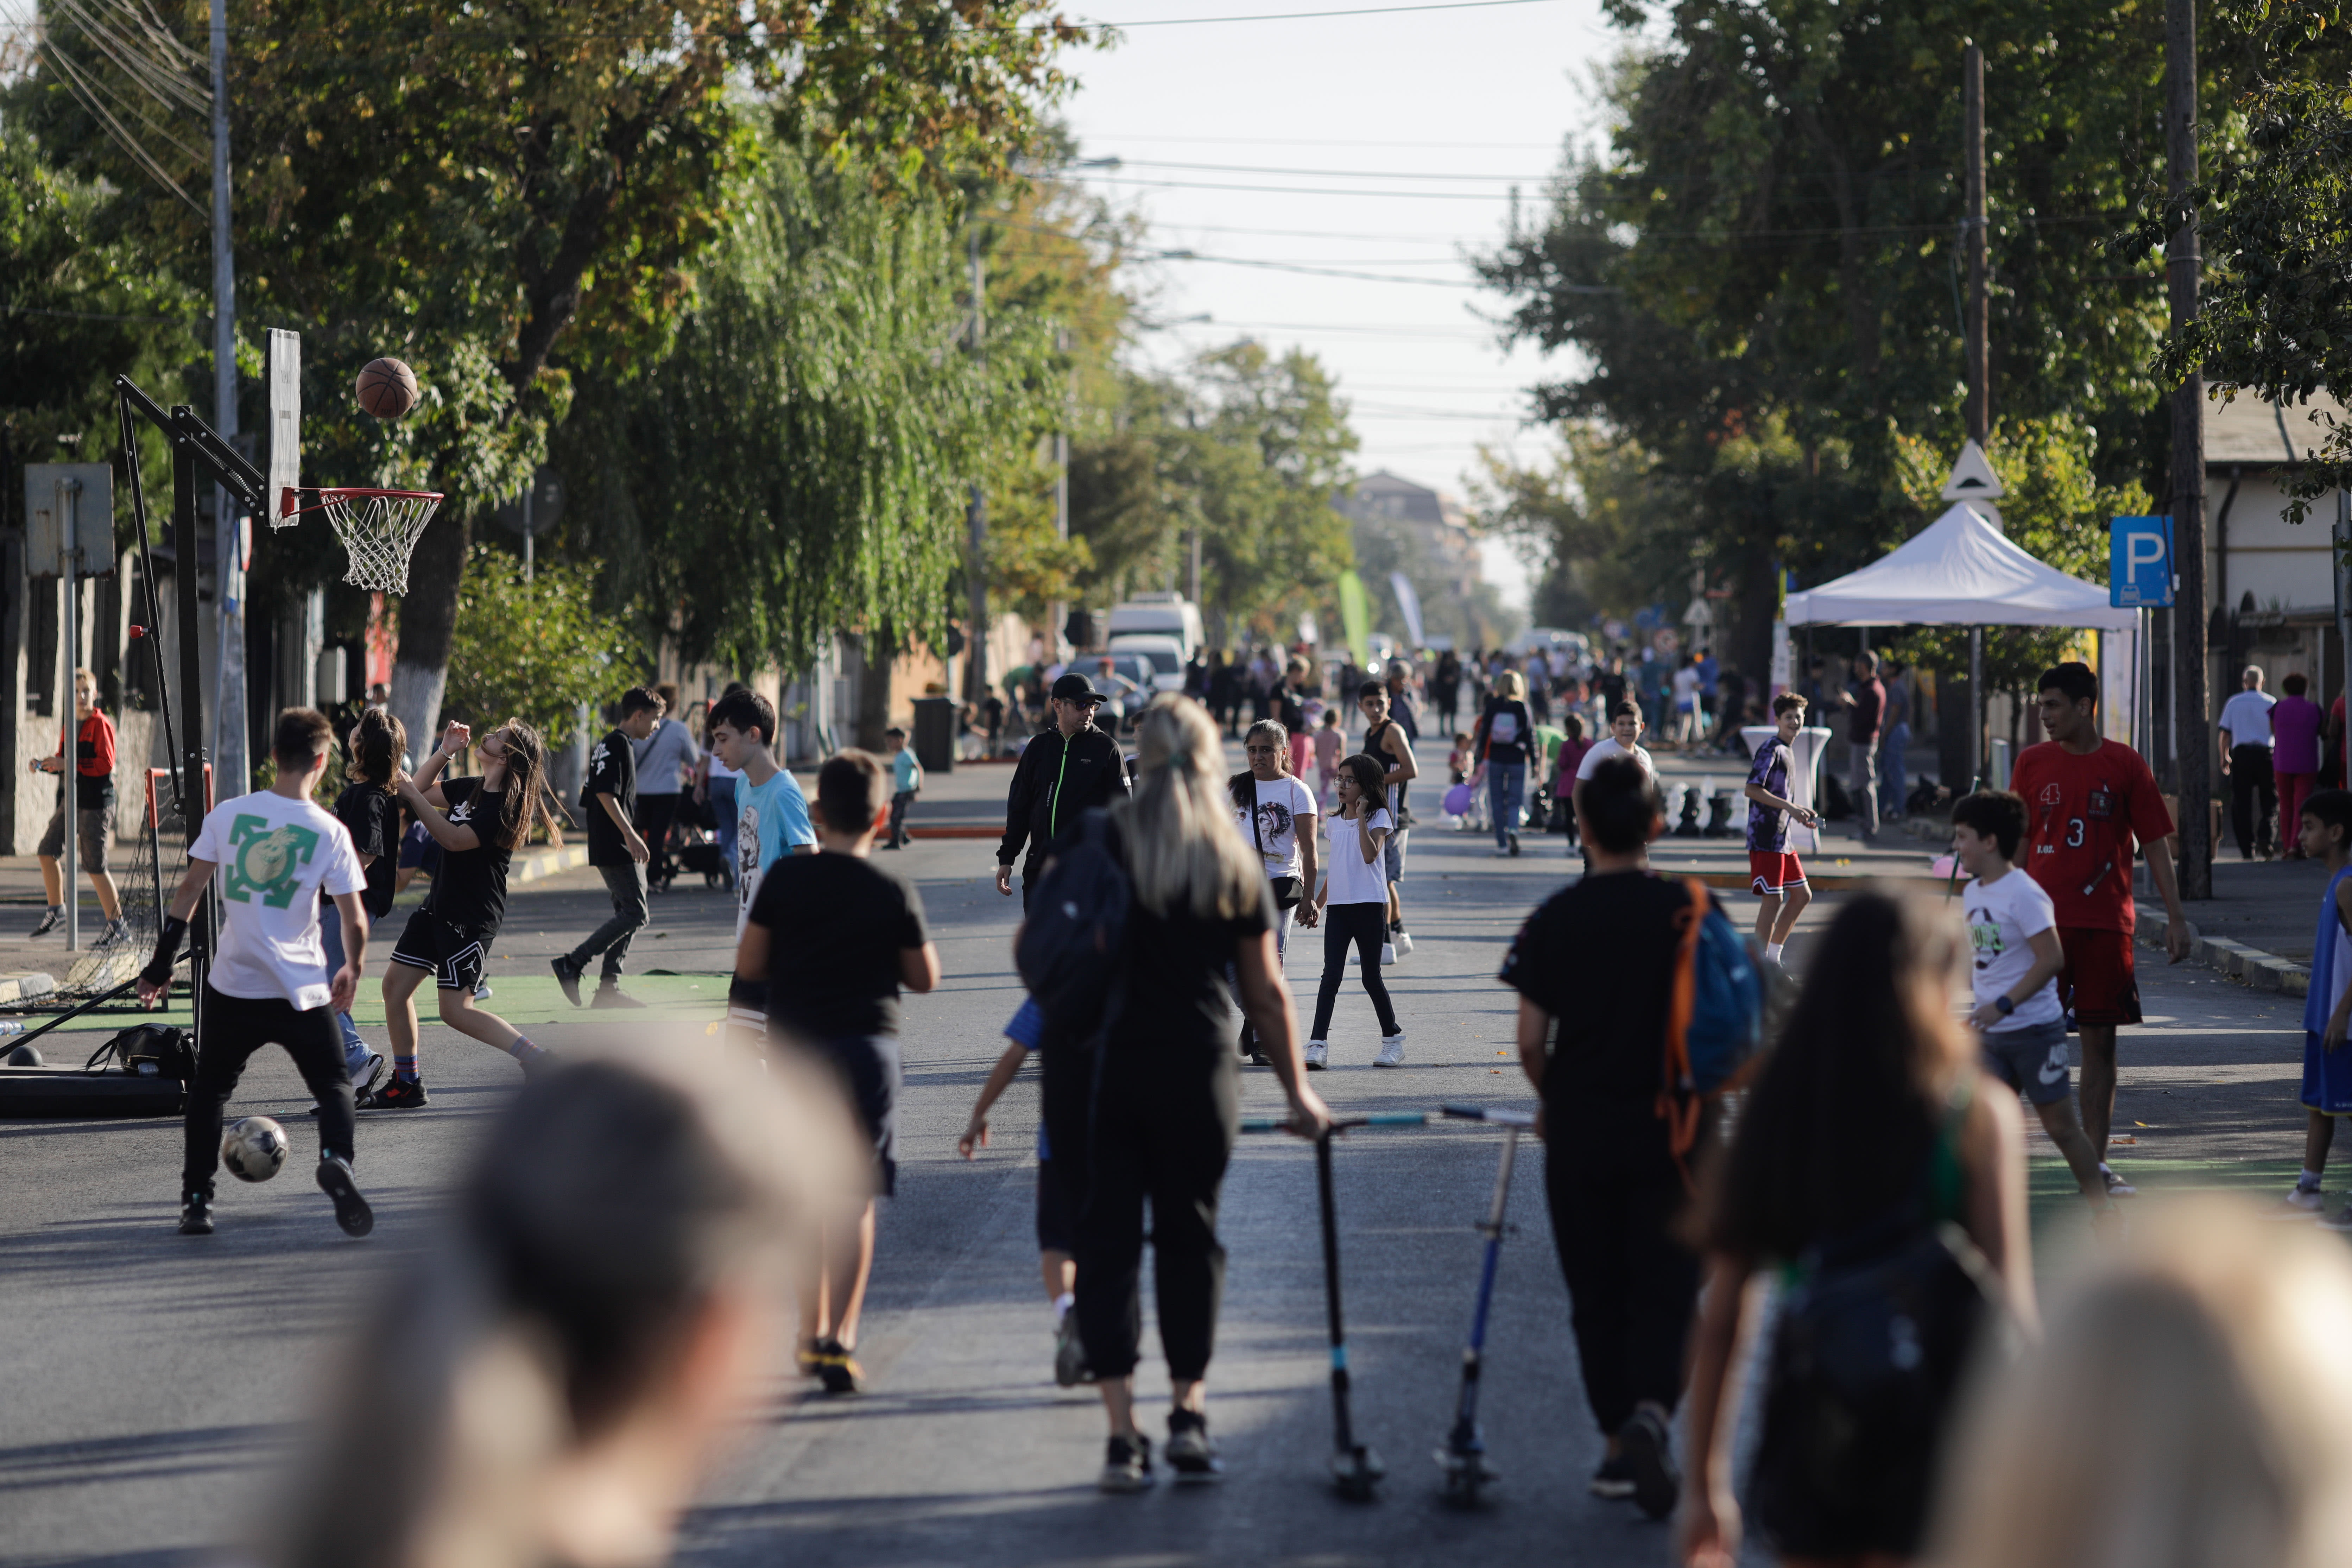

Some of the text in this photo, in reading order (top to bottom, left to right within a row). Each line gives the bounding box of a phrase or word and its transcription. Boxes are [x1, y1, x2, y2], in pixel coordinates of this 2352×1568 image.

[2127, 532, 2166, 584] P
[2041, 783, 2060, 804] 4
[2067, 818, 2084, 847] 3
